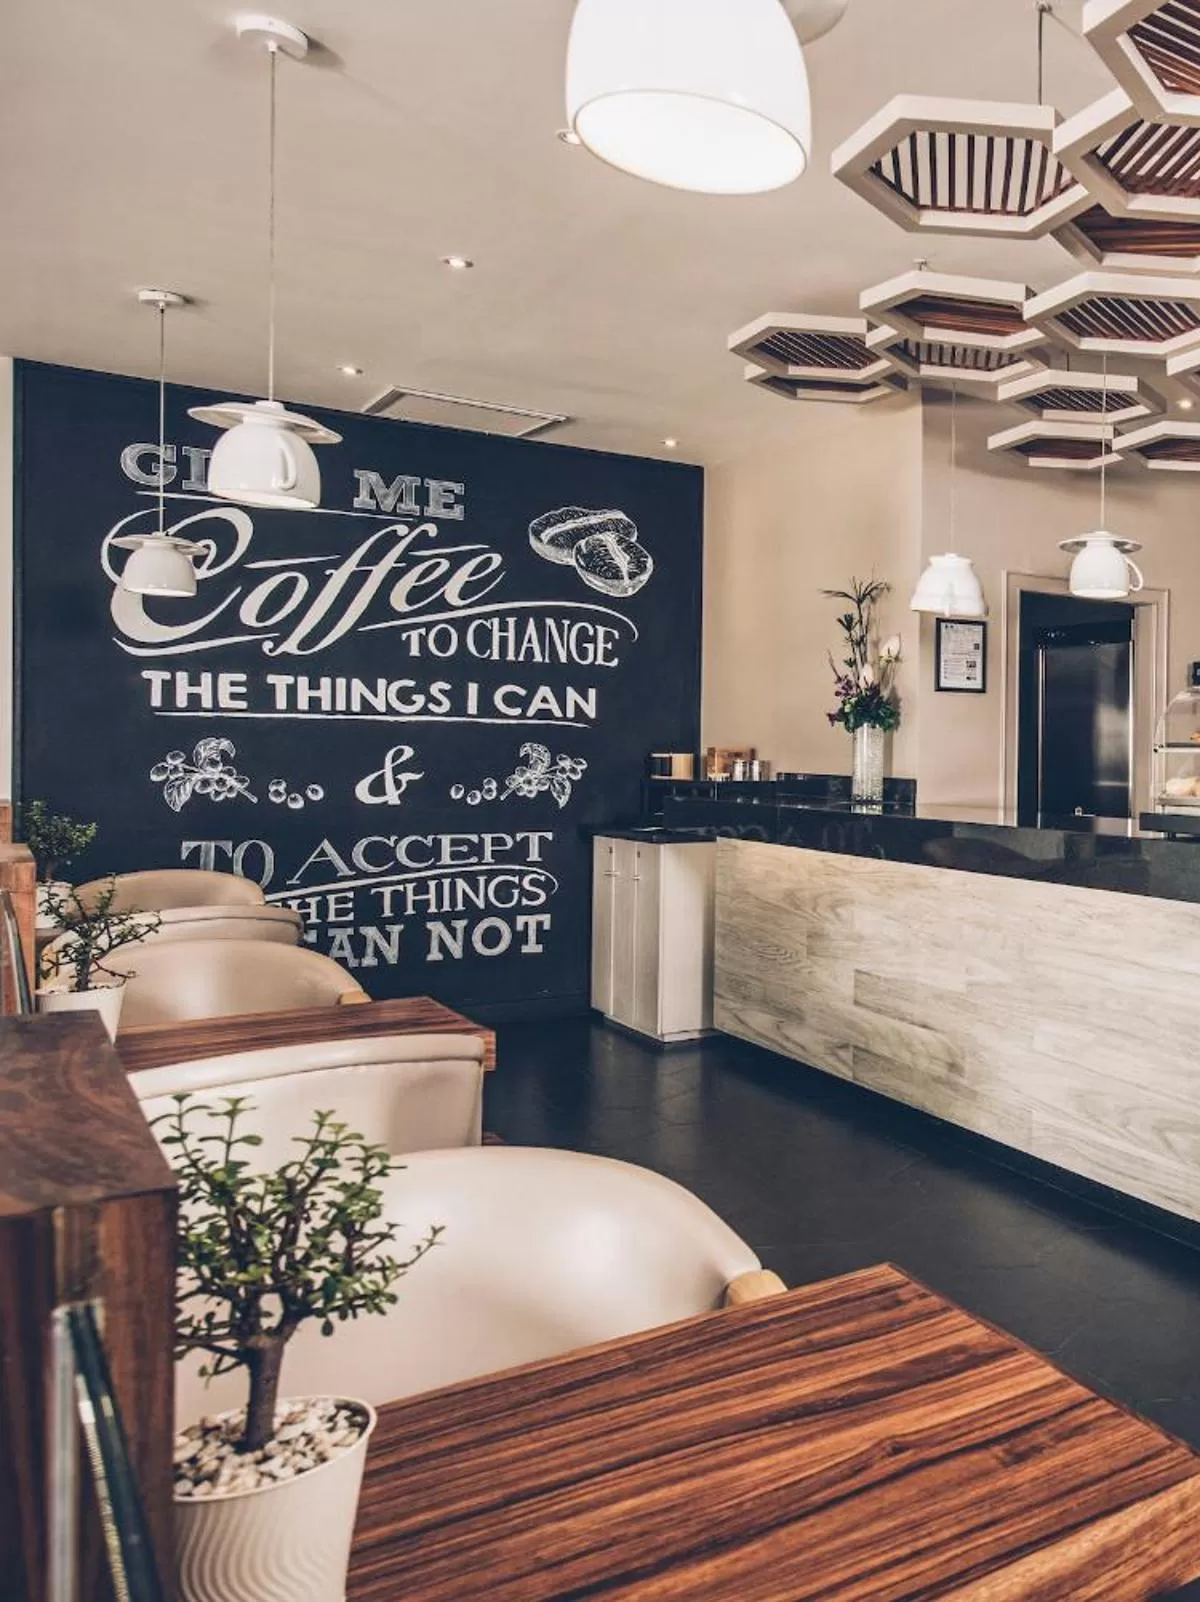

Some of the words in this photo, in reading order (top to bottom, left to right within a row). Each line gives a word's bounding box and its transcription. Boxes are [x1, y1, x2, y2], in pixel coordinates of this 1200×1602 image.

[119, 443, 213, 493] GI
[353, 469, 465, 520] ME
[101, 506, 504, 657] Coffee
[401, 622, 458, 658] TO
[466, 616, 620, 667] CHANGE
[140, 669, 248, 712] THE
[266, 673, 452, 715] THINGS
[466, 681, 479, 715] I
[493, 684, 597, 719] CAN
[354, 744, 425, 806] &
[181, 840, 275, 889] TO
[286, 831, 553, 885] ACCEPT
[266, 891, 355, 924] HE
[370, 873, 546, 918] THINGS
[303, 924, 405, 968] AN
[425, 913, 551, 961] NOT
